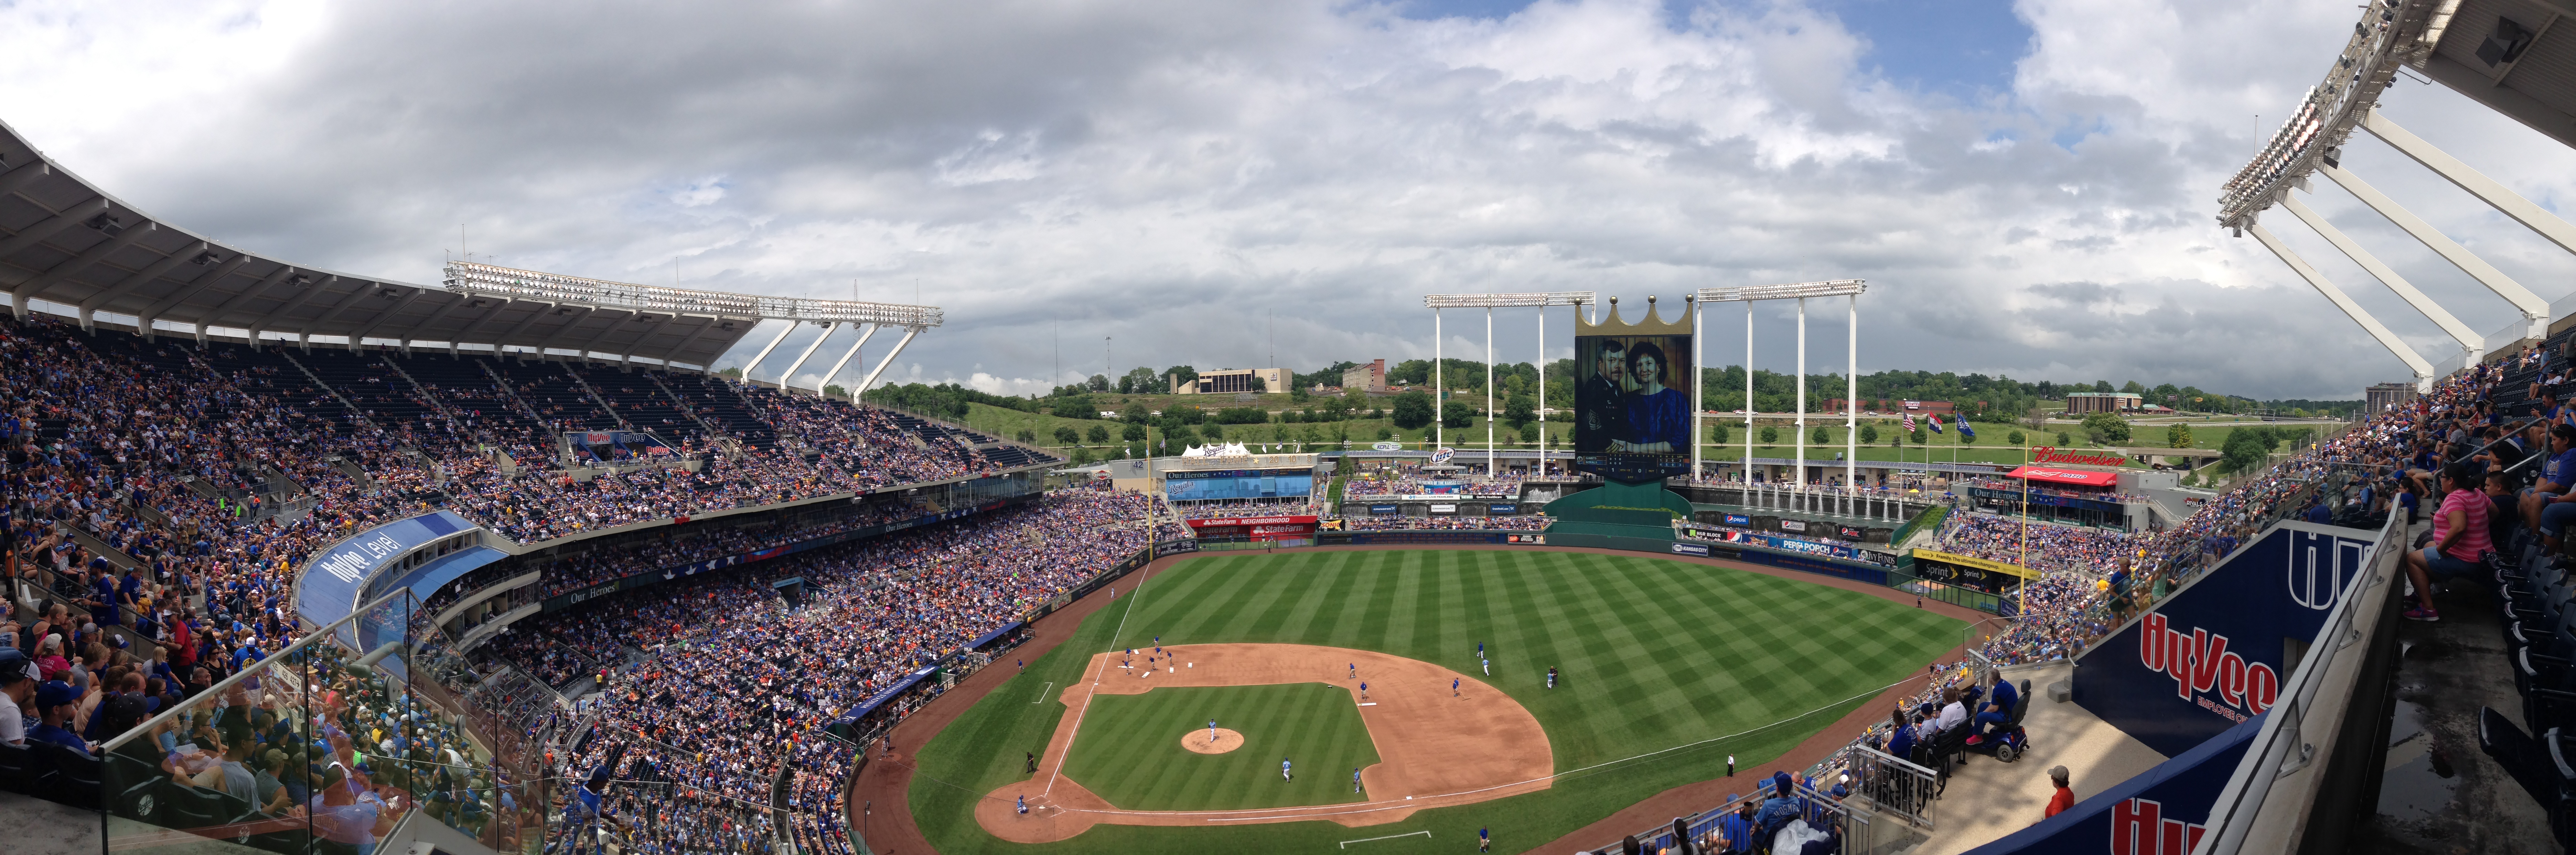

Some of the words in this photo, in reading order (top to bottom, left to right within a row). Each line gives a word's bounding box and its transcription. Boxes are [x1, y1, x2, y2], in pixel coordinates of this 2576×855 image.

[1203, 443, 1226, 457] Royals
[2032, 446, 2126, 466] Budweiser
[1182, 457, 1209, 465] HALL
[1435, 451, 1452, 463] Lite
[1169, 480, 1194, 496] Royals
[1992, 490, 2018, 500] Heroes
[897, 522, 912, 530] Heroes
[353, 532, 402, 560] Level
[1804, 542, 1830, 554] PORCH
[1878, 553, 1895, 565] FUNDS
[1978, 561, 1999, 570] changeup.
[1926, 564, 1948, 577] Sprint
[1964, 569, 1979, 578] Sprint
[571, 593, 585, 604] Our
[590, 584, 615, 599] Heroes
[886, 678, 912, 695] KAUFFMAN
[860, 692, 887, 708] STADIUM
[2198, 695, 2235, 721] EMPLOYEE
